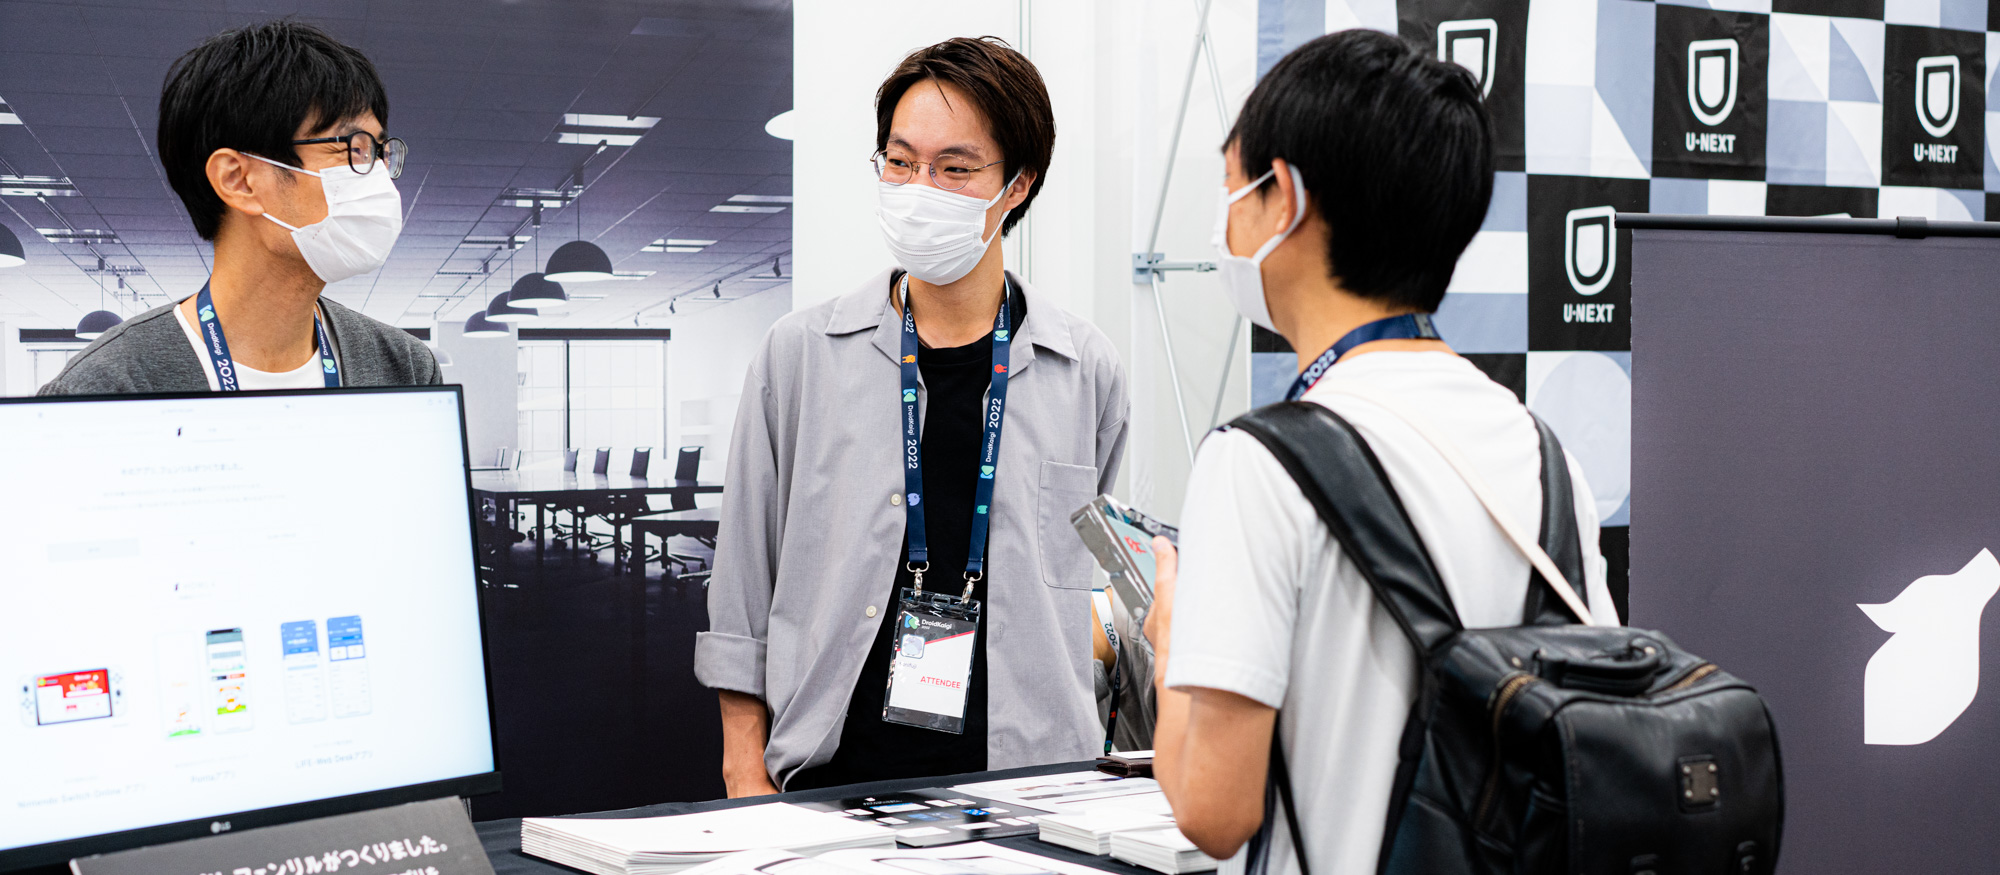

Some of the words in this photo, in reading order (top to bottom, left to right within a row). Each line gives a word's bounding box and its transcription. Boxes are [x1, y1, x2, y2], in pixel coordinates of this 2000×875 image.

[216, 358, 237, 391] 2022
[1302, 348, 1338, 386] 2022
[907, 405, 915, 436] DroidKaigi
[988, 398, 1002, 429] 2022
[907, 439, 918, 470] 2022
[985, 431, 997, 463] DroidKaigi
[921, 619, 952, 630] DroidKaigi
[920, 675, 961, 689] ATTENDEE
[220, 821, 232, 830] LG
